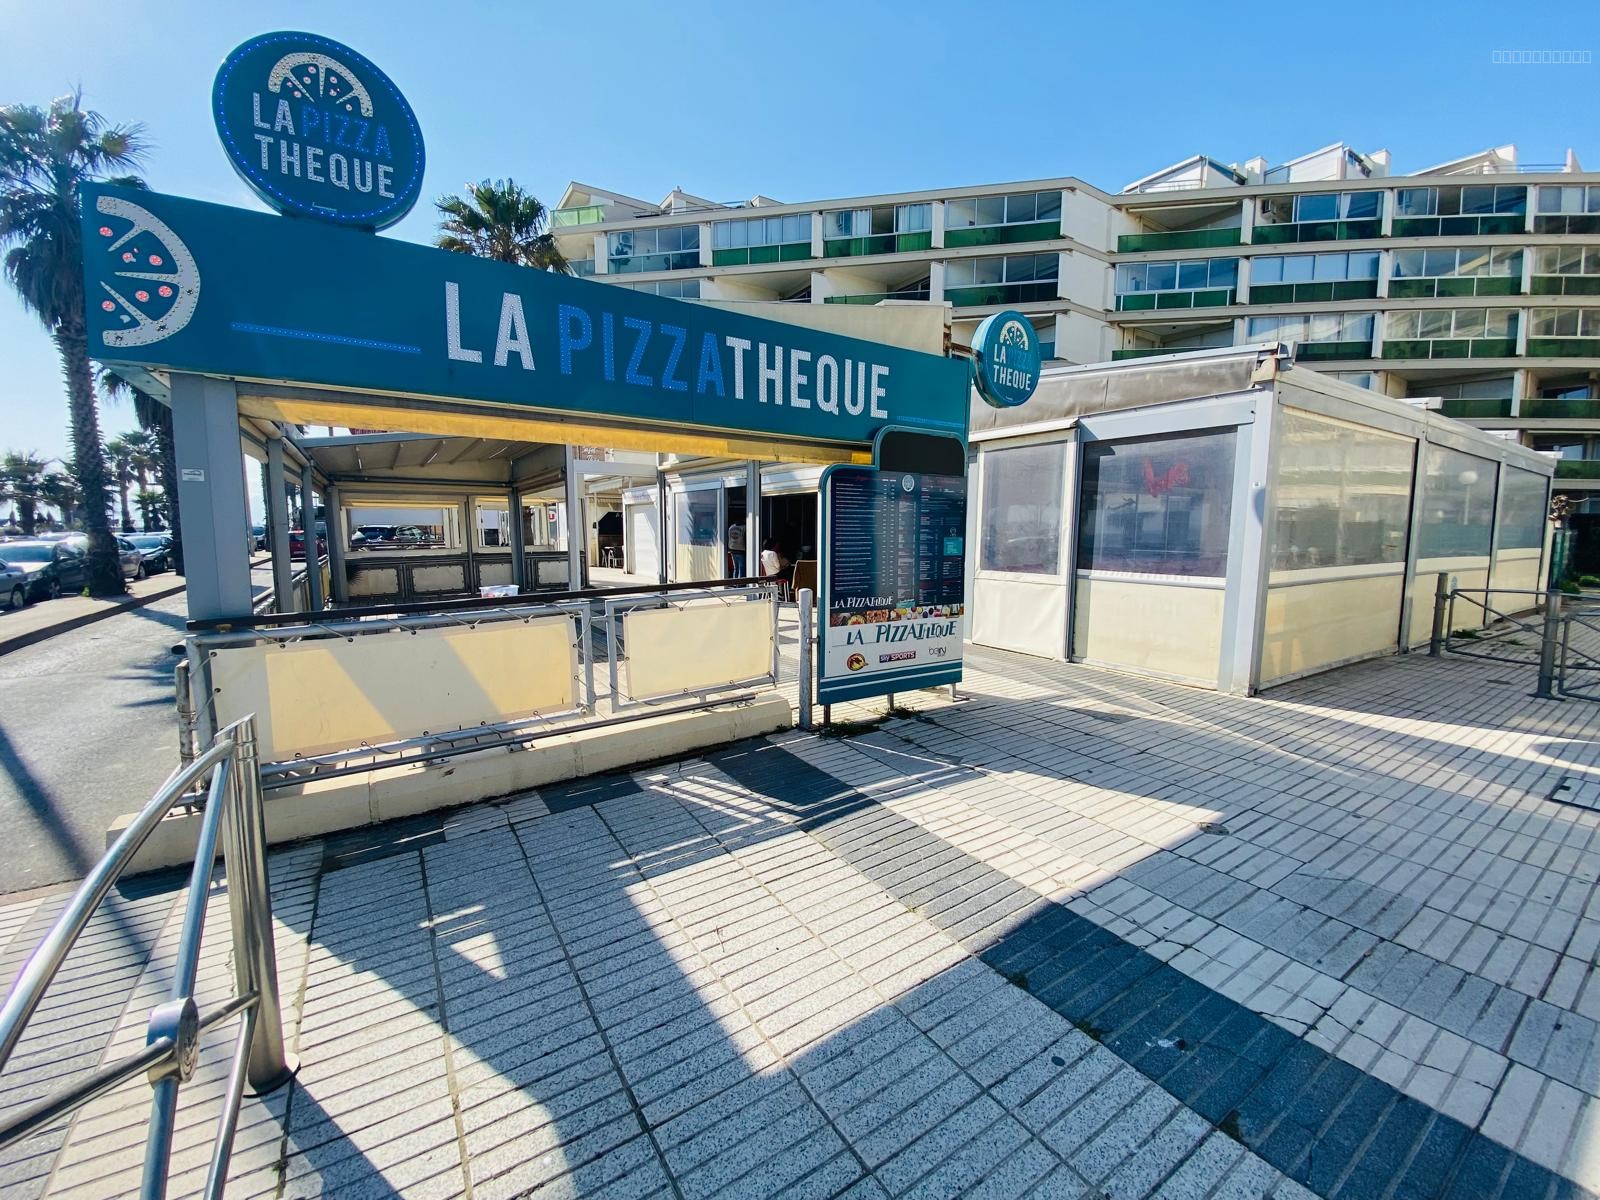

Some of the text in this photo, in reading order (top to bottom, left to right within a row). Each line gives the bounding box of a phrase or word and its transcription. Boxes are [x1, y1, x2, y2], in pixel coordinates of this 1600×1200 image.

[253, 92, 393, 160] LA PIZZA
[254, 133, 395, 199] THEQUE
[445, 281, 536, 371] LA
[993, 343, 1007, 364] LA
[993, 364, 1032, 391] THEQUE
[846, 628, 864, 646] LA
[891, 651, 915, 661] SPORTS
